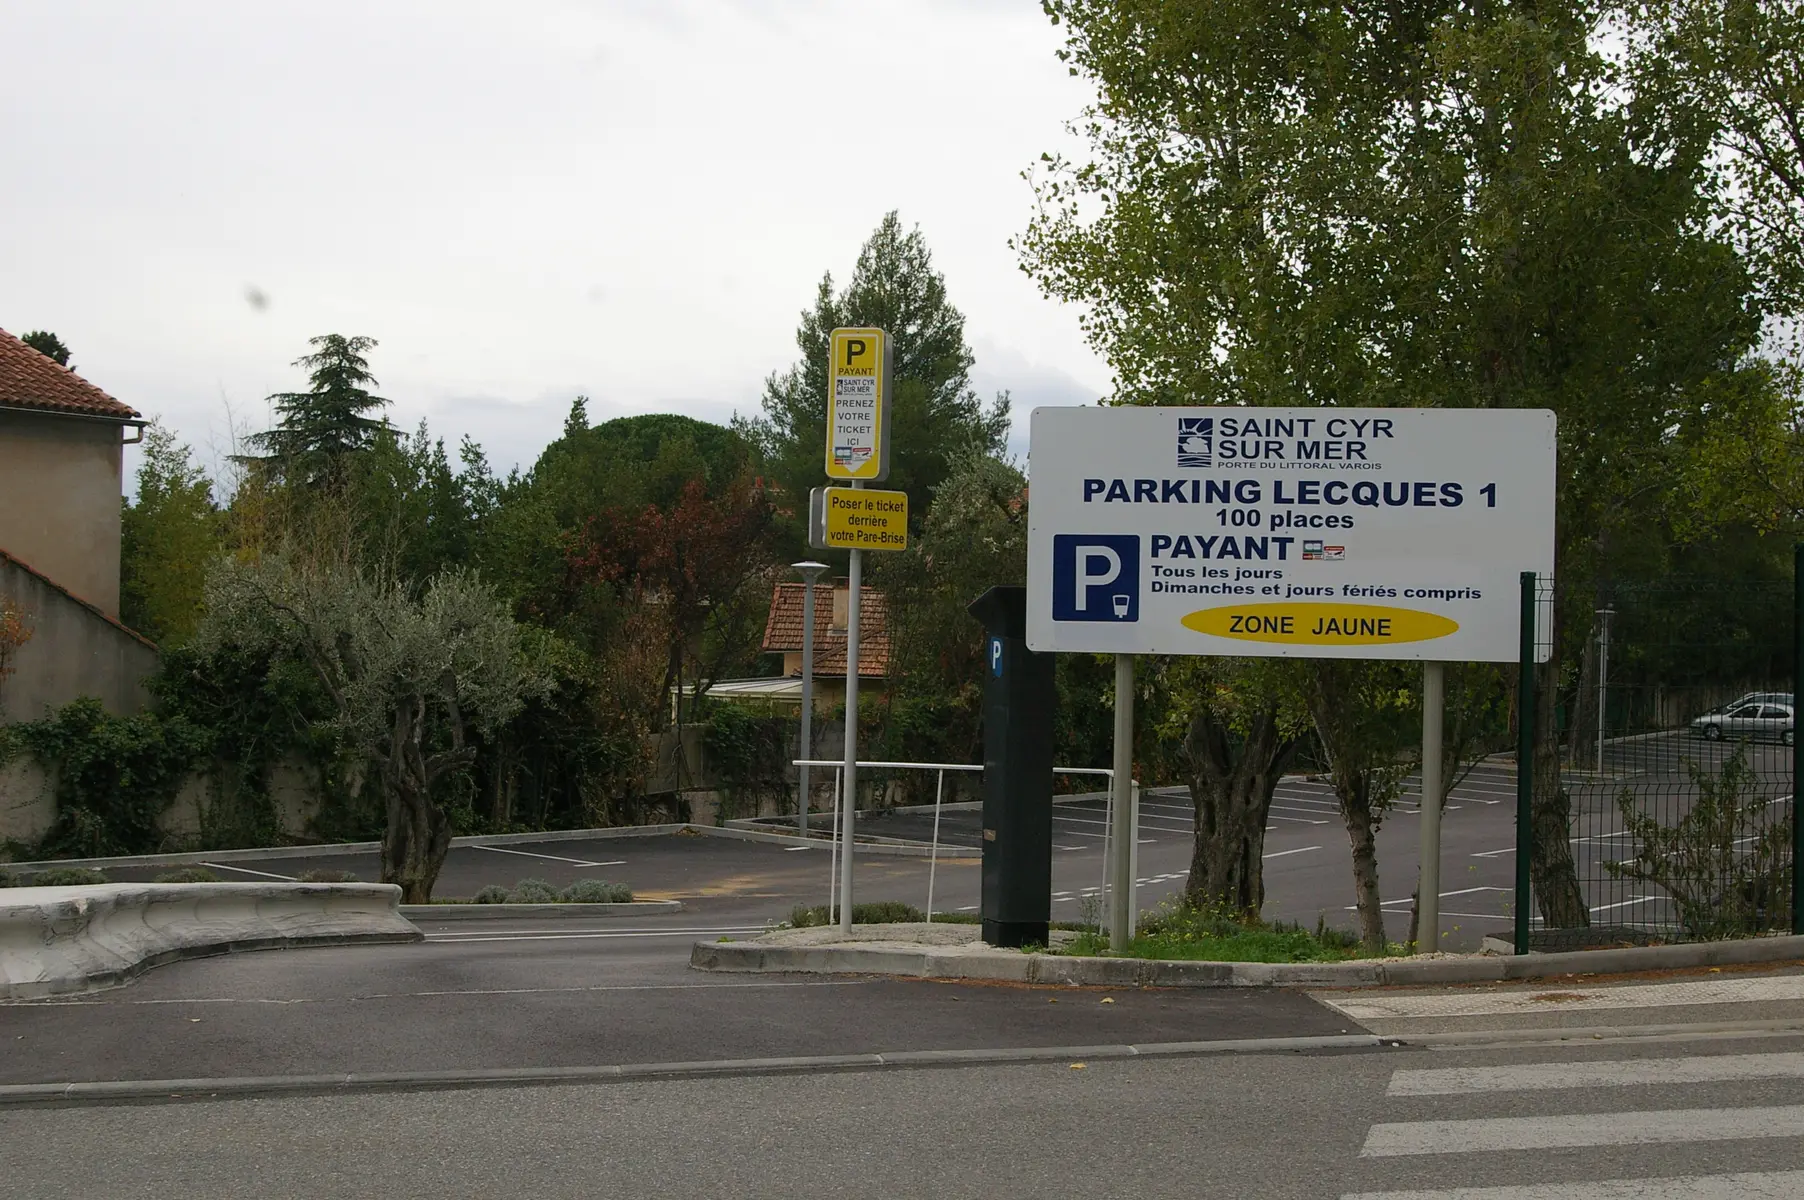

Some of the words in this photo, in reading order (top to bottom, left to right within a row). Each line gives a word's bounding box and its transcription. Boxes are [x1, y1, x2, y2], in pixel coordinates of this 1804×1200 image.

[847, 340, 866, 366] P
[838, 368, 872, 376] PAYANT
[836, 400, 874, 408] PRENEZ
[838, 412, 870, 420] VOTRE
[837, 426, 872, 434] TICKET
[1219, 418, 1316, 438] SAINT
[1326, 418, 1394, 438] CYR
[1218, 440, 1286, 460] SUR
[1296, 440, 1368, 460] MER
[1338, 462, 1382, 470] VAROIS
[1083, 478, 1262, 504] PARKING
[1273, 480, 1464, 508] LECQUES
[1479, 483, 1496, 508] 1
[832, 496, 862, 510] Poser
[864, 499, 874, 511] le
[876, 500, 904, 512] ticket
[848, 514, 888, 527] derrière
[1216, 508, 1261, 527] 100
[1270, 510, 1354, 532] places
[830, 530, 854, 541] votre
[856, 530, 904, 544] Pare-Brise
[1150, 534, 1294, 560] PAYANT
[1076, 545, 1122, 611] P
[1151, 566, 1196, 578] Tous
[1202, 566, 1230, 578] les
[1234, 566, 1283, 582] jours
[1151, 581, 1255, 595] Dimanches
[1262, 584, 1280, 596] et
[1285, 584, 1334, 598] jours
[1342, 584, 1397, 598] fériés
[1404, 587, 1482, 601] compris
[1229, 616, 1294, 634] ZONE
[1312, 618, 1392, 636] JAUNE
[992, 640, 1001, 670] P
